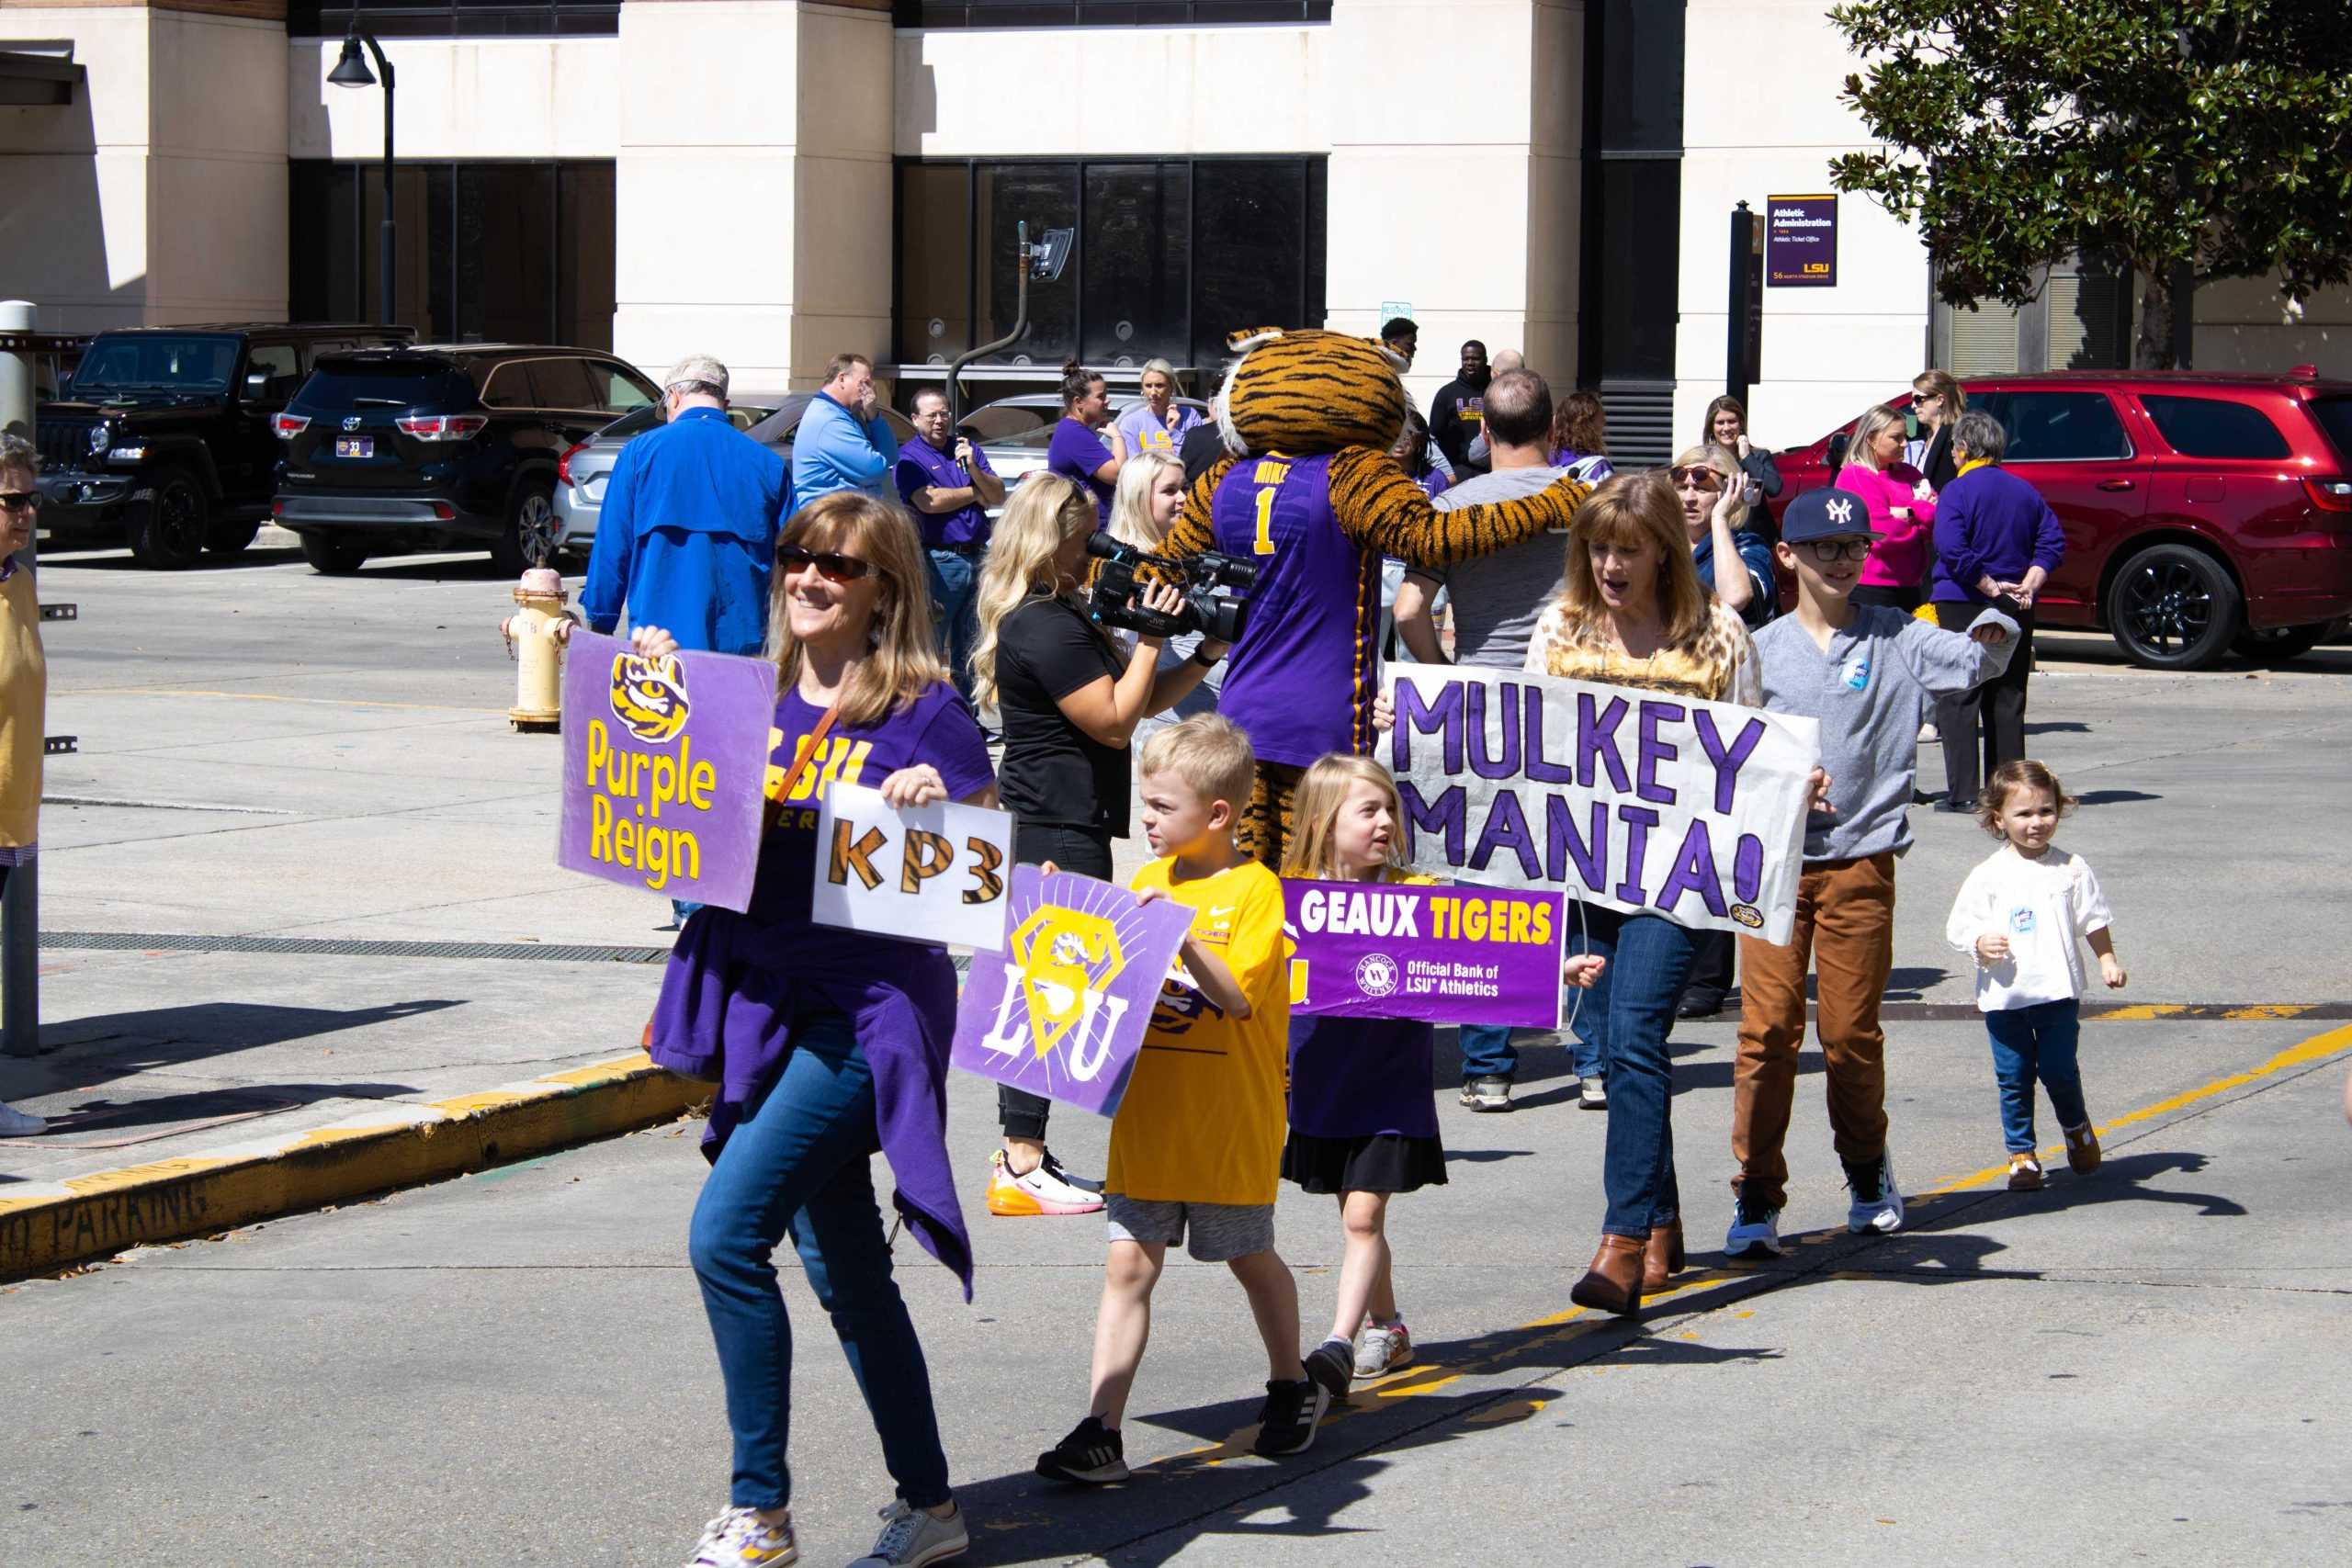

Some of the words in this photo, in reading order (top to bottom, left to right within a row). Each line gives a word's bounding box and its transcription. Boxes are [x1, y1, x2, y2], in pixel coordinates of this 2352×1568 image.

[1773, 208, 1805, 217] Athletic
[1773, 218, 1832, 228] Administration
[1804, 264, 1829, 273] LSU
[1456, 397, 1486, 412] LS
[1139, 430, 1173, 449] LS
[1253, 487, 1276, 556] 1
[1391, 676, 1766, 816] MULKEY
[586, 718, 717, 822] Purple
[589, 793, 701, 891] Reign
[828, 817, 1005, 905] KP3
[1396, 779, 1765, 929] MANIA!
[1299, 889, 1420, 939] GEAUX
[1430, 896, 1553, 946] TIGERS
[1359, 955, 1396, 972] HANCOCK
[1407, 960, 1451, 976] Official
[1453, 963, 1484, 978] Bank
[1486, 965, 1499, 979] of
[1359, 976, 1396, 996] WHITNEY
[1439, 979, 1499, 998] Athletics
[52, 1180, 208, 1254] PARKING
